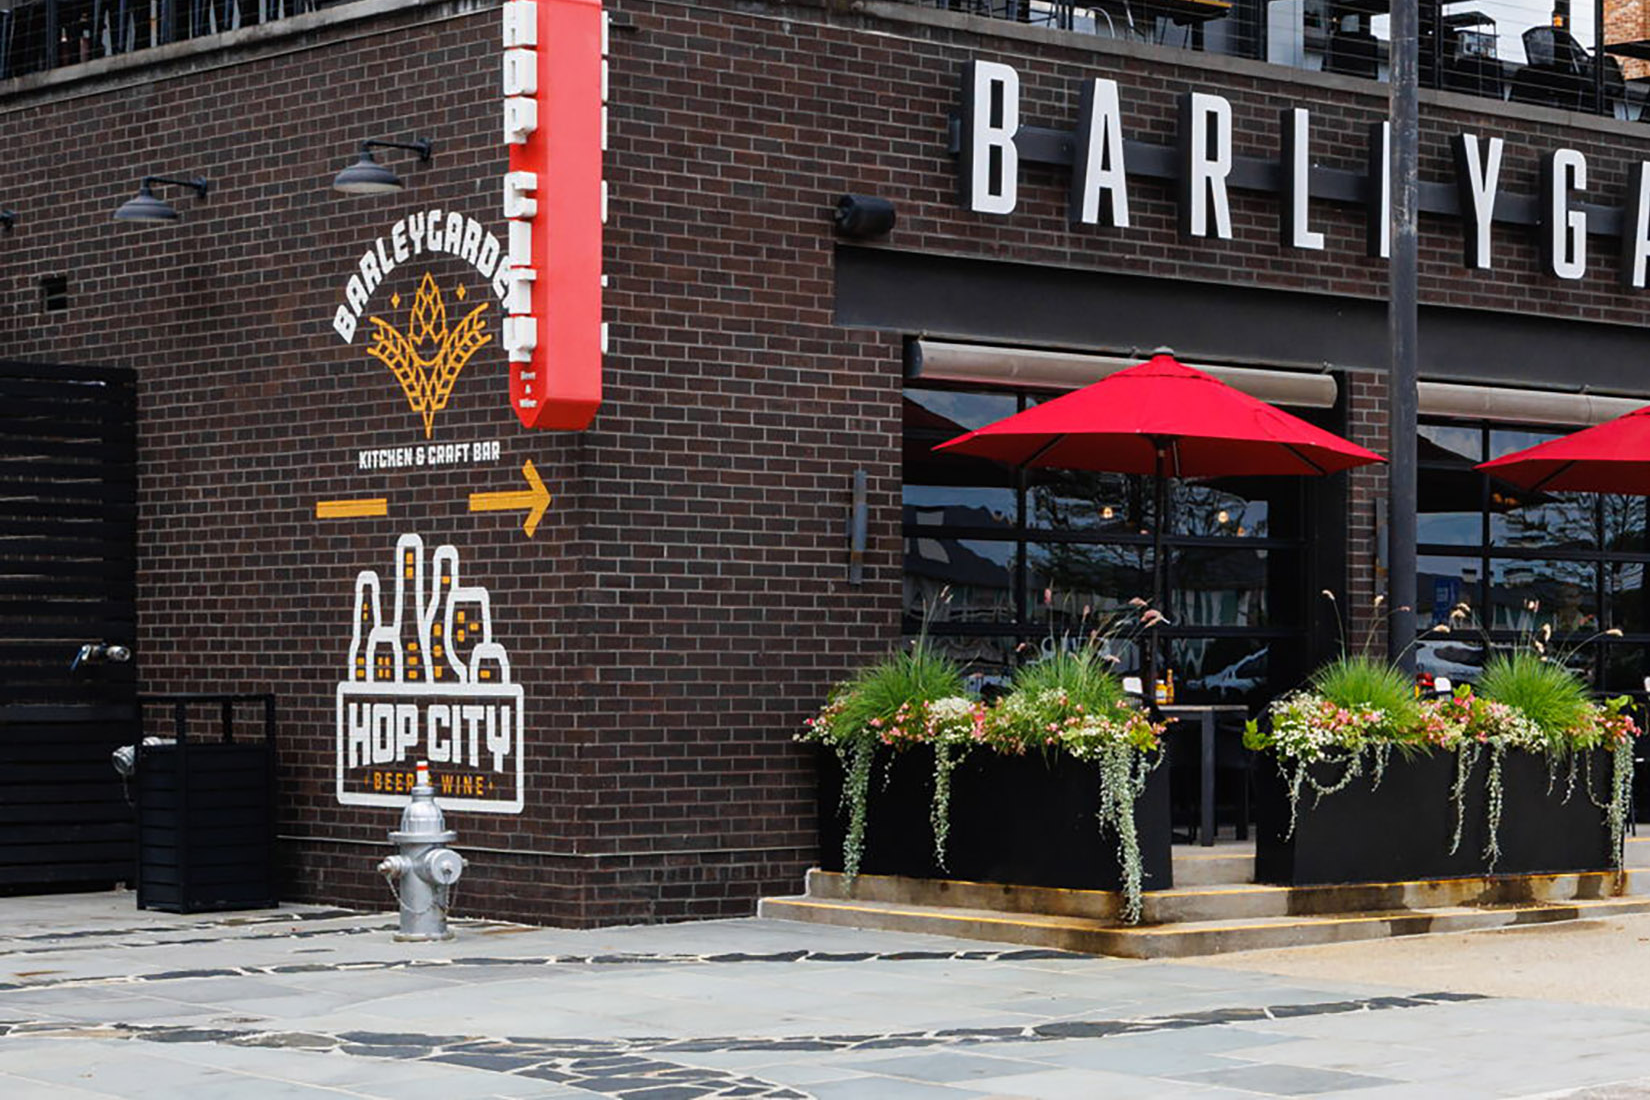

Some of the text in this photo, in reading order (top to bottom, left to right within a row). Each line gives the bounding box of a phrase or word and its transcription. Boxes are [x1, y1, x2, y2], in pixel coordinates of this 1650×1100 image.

[359, 441, 500, 469] KITCHEN & CRAFT BAR
[348, 702, 511, 774] HOP CITY
[373, 771, 415, 792] BEER
[441, 774, 485, 796] WINE
